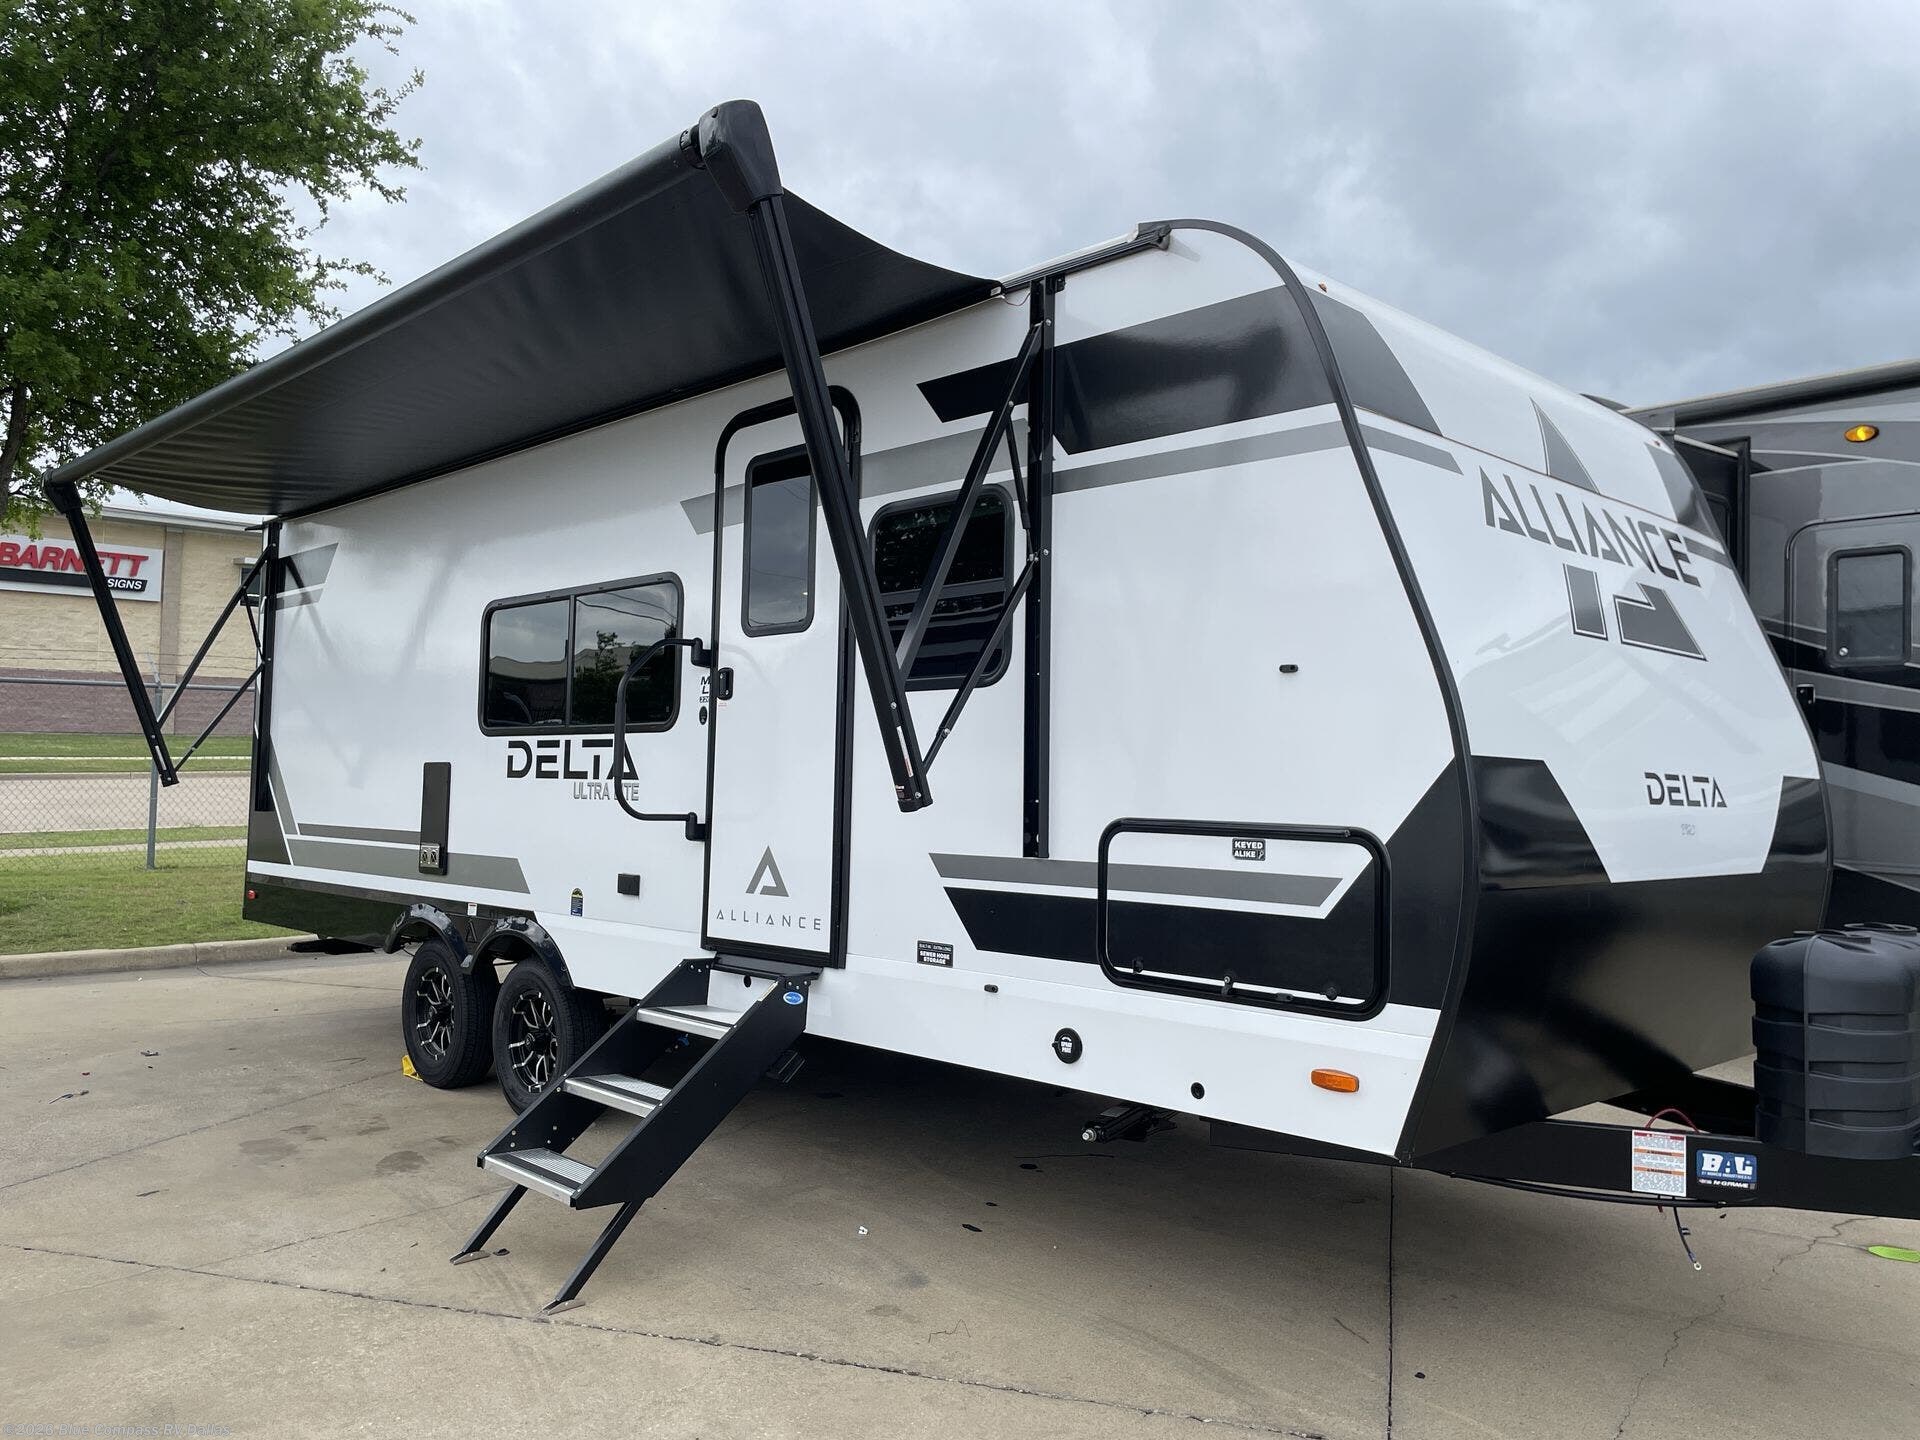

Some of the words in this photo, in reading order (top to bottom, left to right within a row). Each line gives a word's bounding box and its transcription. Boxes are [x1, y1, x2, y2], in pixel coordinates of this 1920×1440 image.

[1479, 465, 1702, 588] ALLIANCE
[107, 579, 142, 590] SIGNS
[507, 739, 639, 780] DELTA
[573, 782, 610, 800] ULTRA
[1644, 772, 1728, 808] DELTA
[1234, 841, 1263, 849] KEYED
[1234, 850, 1256, 858] ALIKE
[716, 909, 821, 931] ALLIANCE
[1702, 1153, 1753, 1175] BAL
